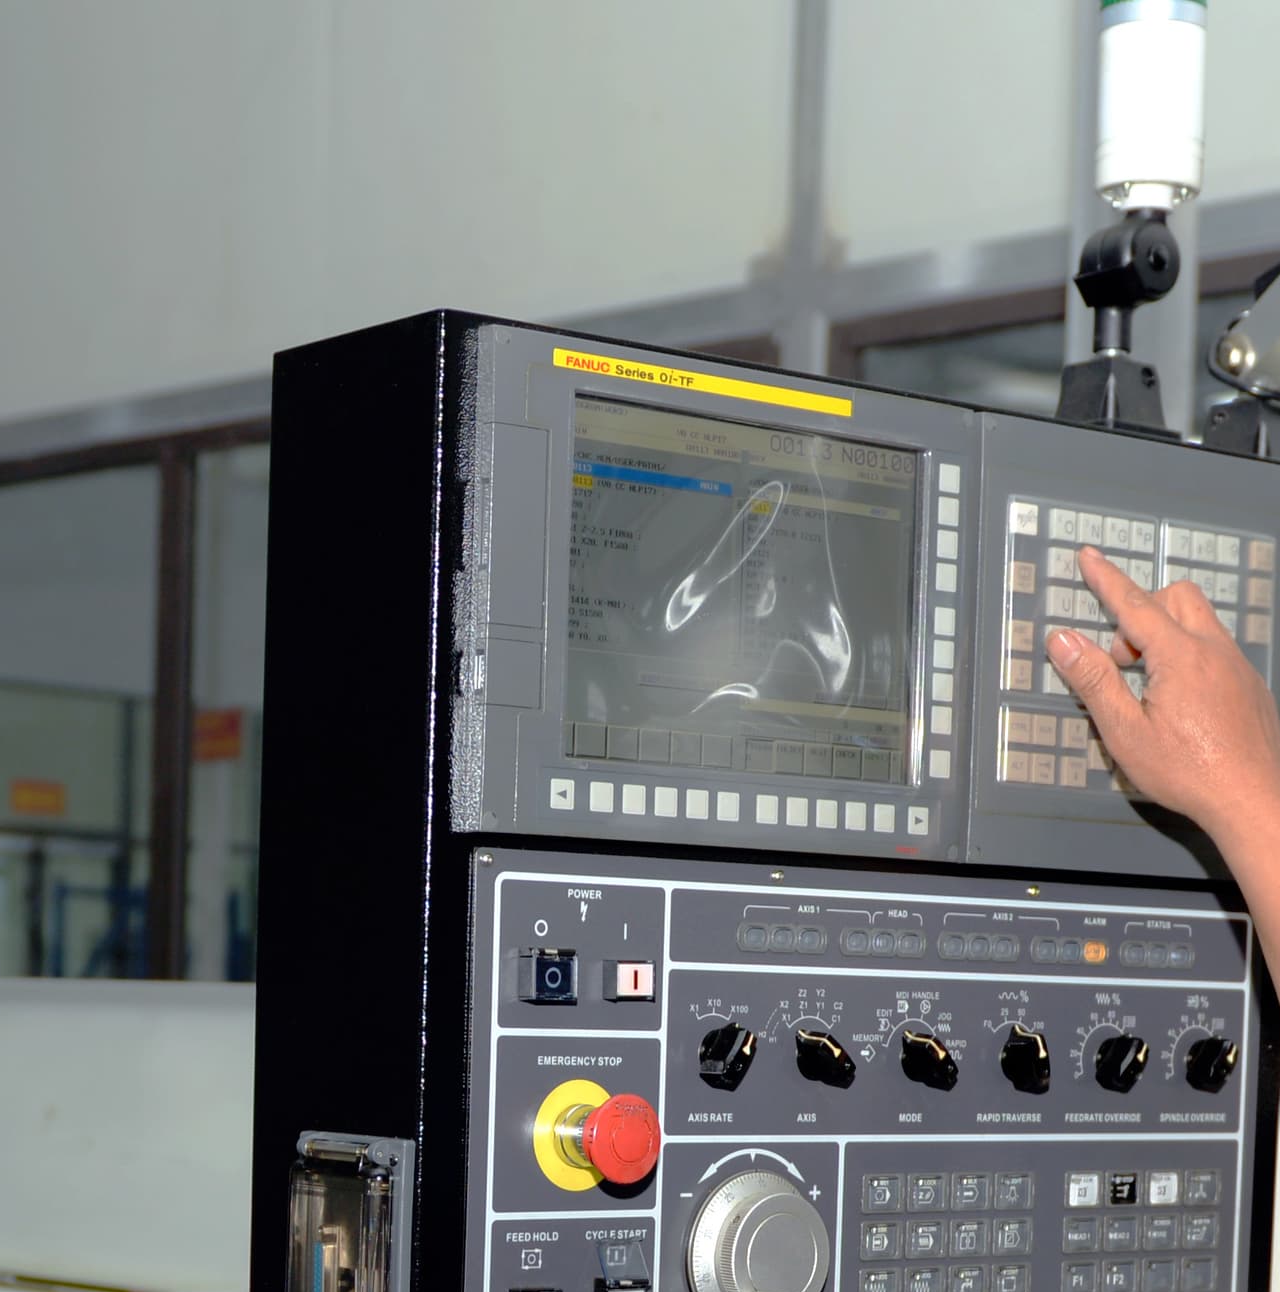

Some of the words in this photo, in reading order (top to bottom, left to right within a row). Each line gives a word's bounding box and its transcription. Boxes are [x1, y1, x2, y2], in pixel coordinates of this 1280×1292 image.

[565, 355, 610, 373] FANUC
[615, 364, 655, 381] Series
[841, 447, 915, 474] N00100
[567, 888, 602, 900] POWER
[797, 905, 815, 915] AXIS
[888, 909, 908, 919] HEAD
[993, 912, 1009, 922] AXIS
[1083, 917, 1107, 926] ALARM
[1147, 919, 1172, 930] STATUS
[798, 989, 807, 997] Z2
[816, 989, 825, 997] Y2
[896, 991, 910, 999] MDI
[911, 991, 940, 1000] HANDLE
[708, 999, 721, 1007] X10
[780, 1001, 789, 1009] X2
[799, 1001, 808, 1010] Z1
[816, 1001, 825, 1010] Y1
[834, 1002, 844, 1010] C2
[689, 1004, 700, 1012] X1
[730, 1005, 749, 1014] X100
[782, 1013, 791, 1022] X1
[876, 1009, 893, 1017] EDIT
[937, 1013, 952, 1021] JOG
[832, 1014, 841, 1023] C1
[852, 1034, 884, 1042] MEMORY
[945, 1040, 967, 1048] RAPID
[537, 1055, 596, 1067] EMERGENCY
[598, 1056, 623, 1067] STOP
[688, 1113, 708, 1123] AXIS
[710, 1112, 733, 1122] RATE
[796, 1113, 817, 1123] AXIS
[898, 1113, 922, 1122] MODE
[976, 1113, 1000, 1122] RAPID
[1002, 1113, 1042, 1122] TRAVERSE
[1065, 1113, 1103, 1122] FEEDRATE
[1104, 1113, 1141, 1123] OVERRIDE
[1160, 1113, 1189, 1122] SPINDLE
[1191, 1113, 1226, 1123] OVERRIDE
[506, 1232, 531, 1243] FEED
[532, 1231, 559, 1241] HOLD
[617, 1229, 647, 1239] START
[1072, 1275, 1083, 1287] F1
[1113, 1274, 1124, 1285] F2
